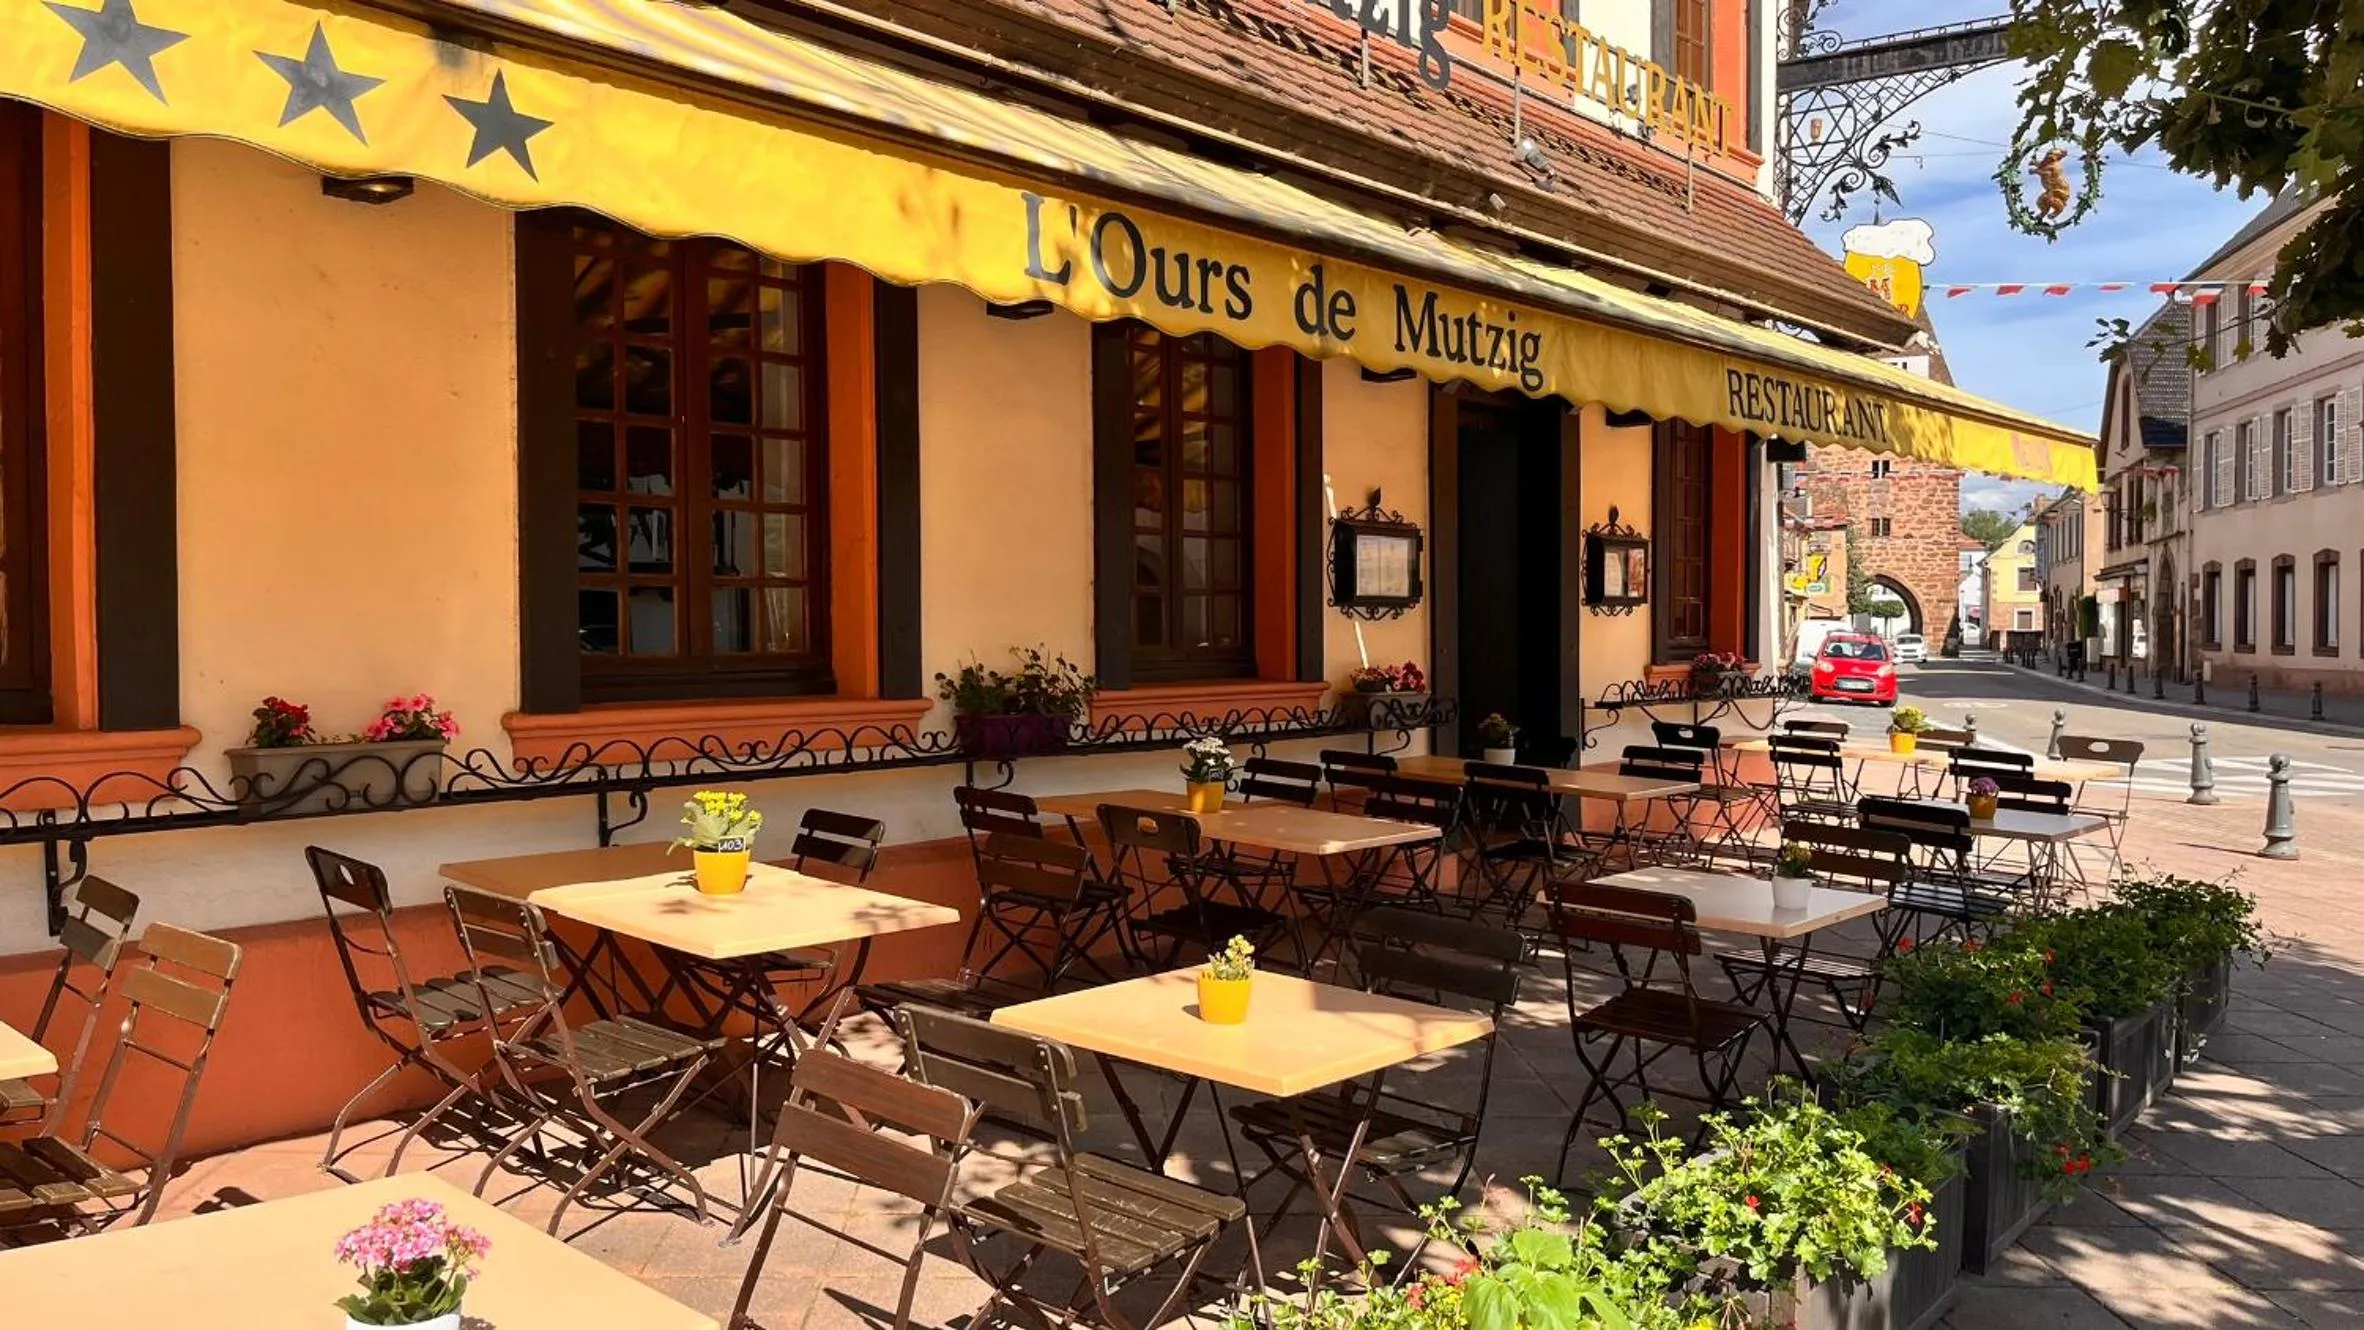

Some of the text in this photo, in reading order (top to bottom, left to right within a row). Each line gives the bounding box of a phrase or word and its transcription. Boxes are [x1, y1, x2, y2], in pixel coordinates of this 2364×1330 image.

[1481, 0, 1732, 160] RESTAURANT
[1021, 191, 1544, 393] L'Ours de Mutzig
[1726, 367, 1888, 444] RESTAURANT
